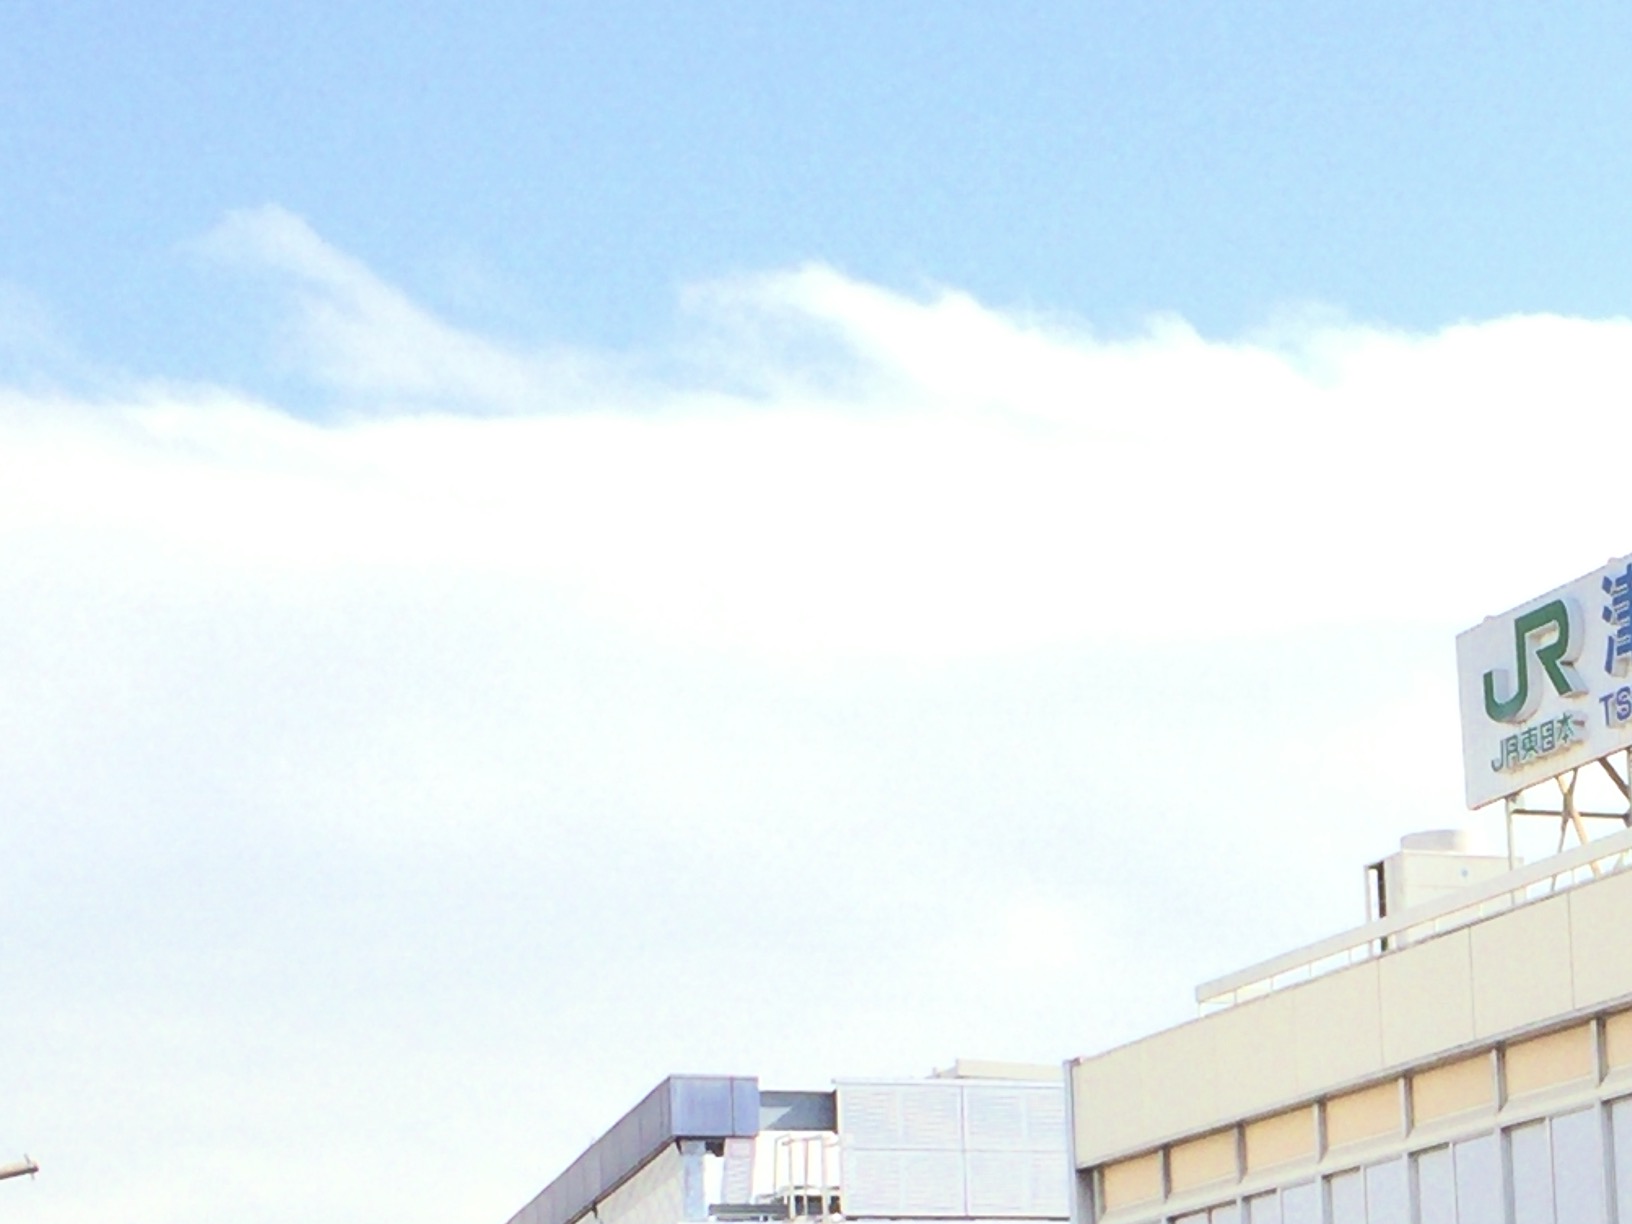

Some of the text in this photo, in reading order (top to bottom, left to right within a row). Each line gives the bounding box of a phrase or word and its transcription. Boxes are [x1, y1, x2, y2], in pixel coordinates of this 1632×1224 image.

[1483, 599, 1573, 723] JR
[1491, 711, 1575, 774] JR東日本
